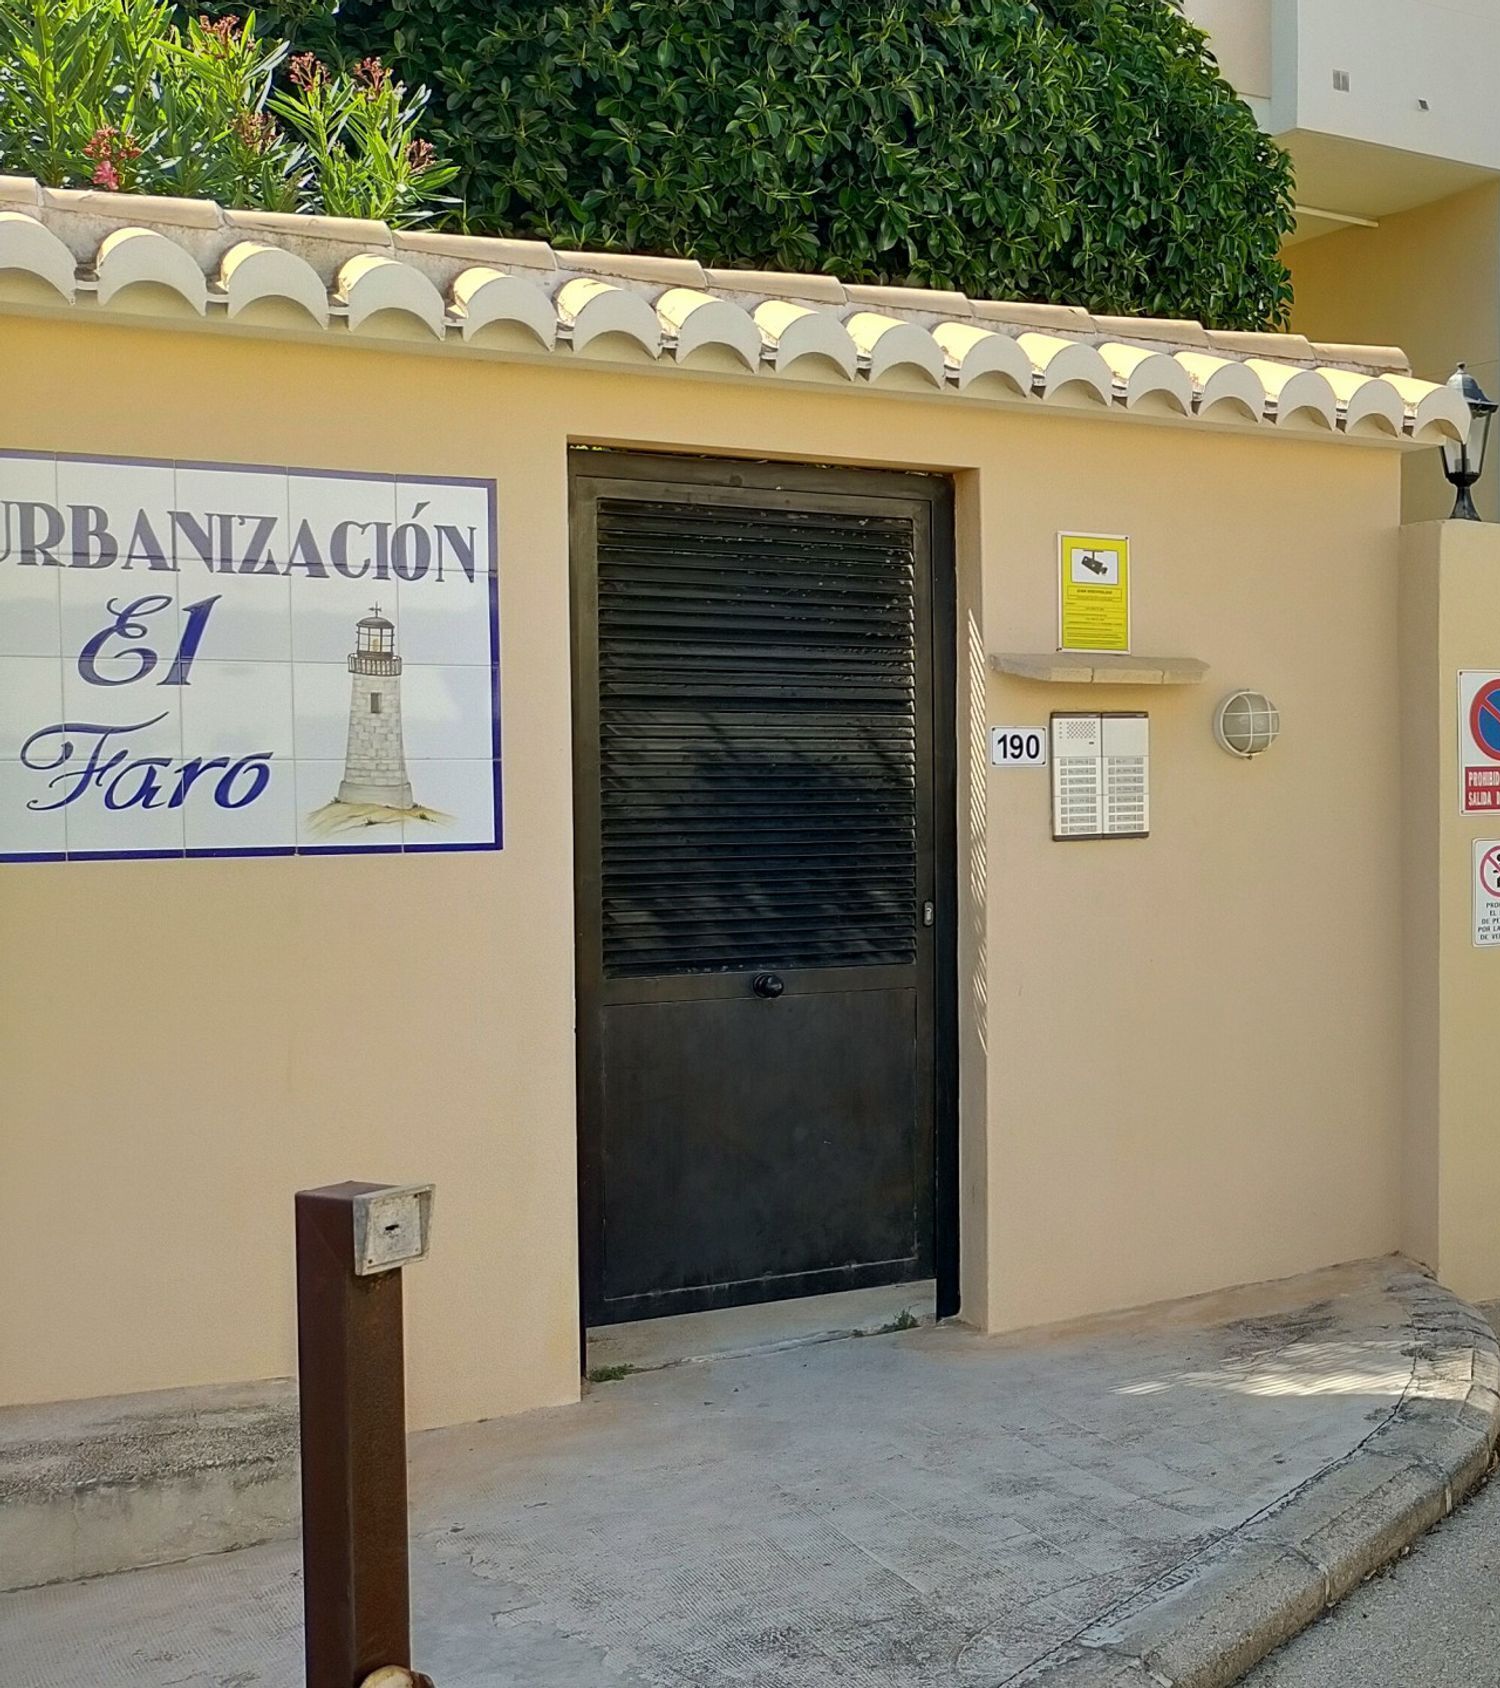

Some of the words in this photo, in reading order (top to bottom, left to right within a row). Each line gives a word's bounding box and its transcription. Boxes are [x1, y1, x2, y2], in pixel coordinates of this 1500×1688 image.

[78, 594, 222, 686] El
[20, 711, 273, 811] Faro
[997, 734, 1040, 759] 190
[1468, 791, 1492, 806] SALIDA
